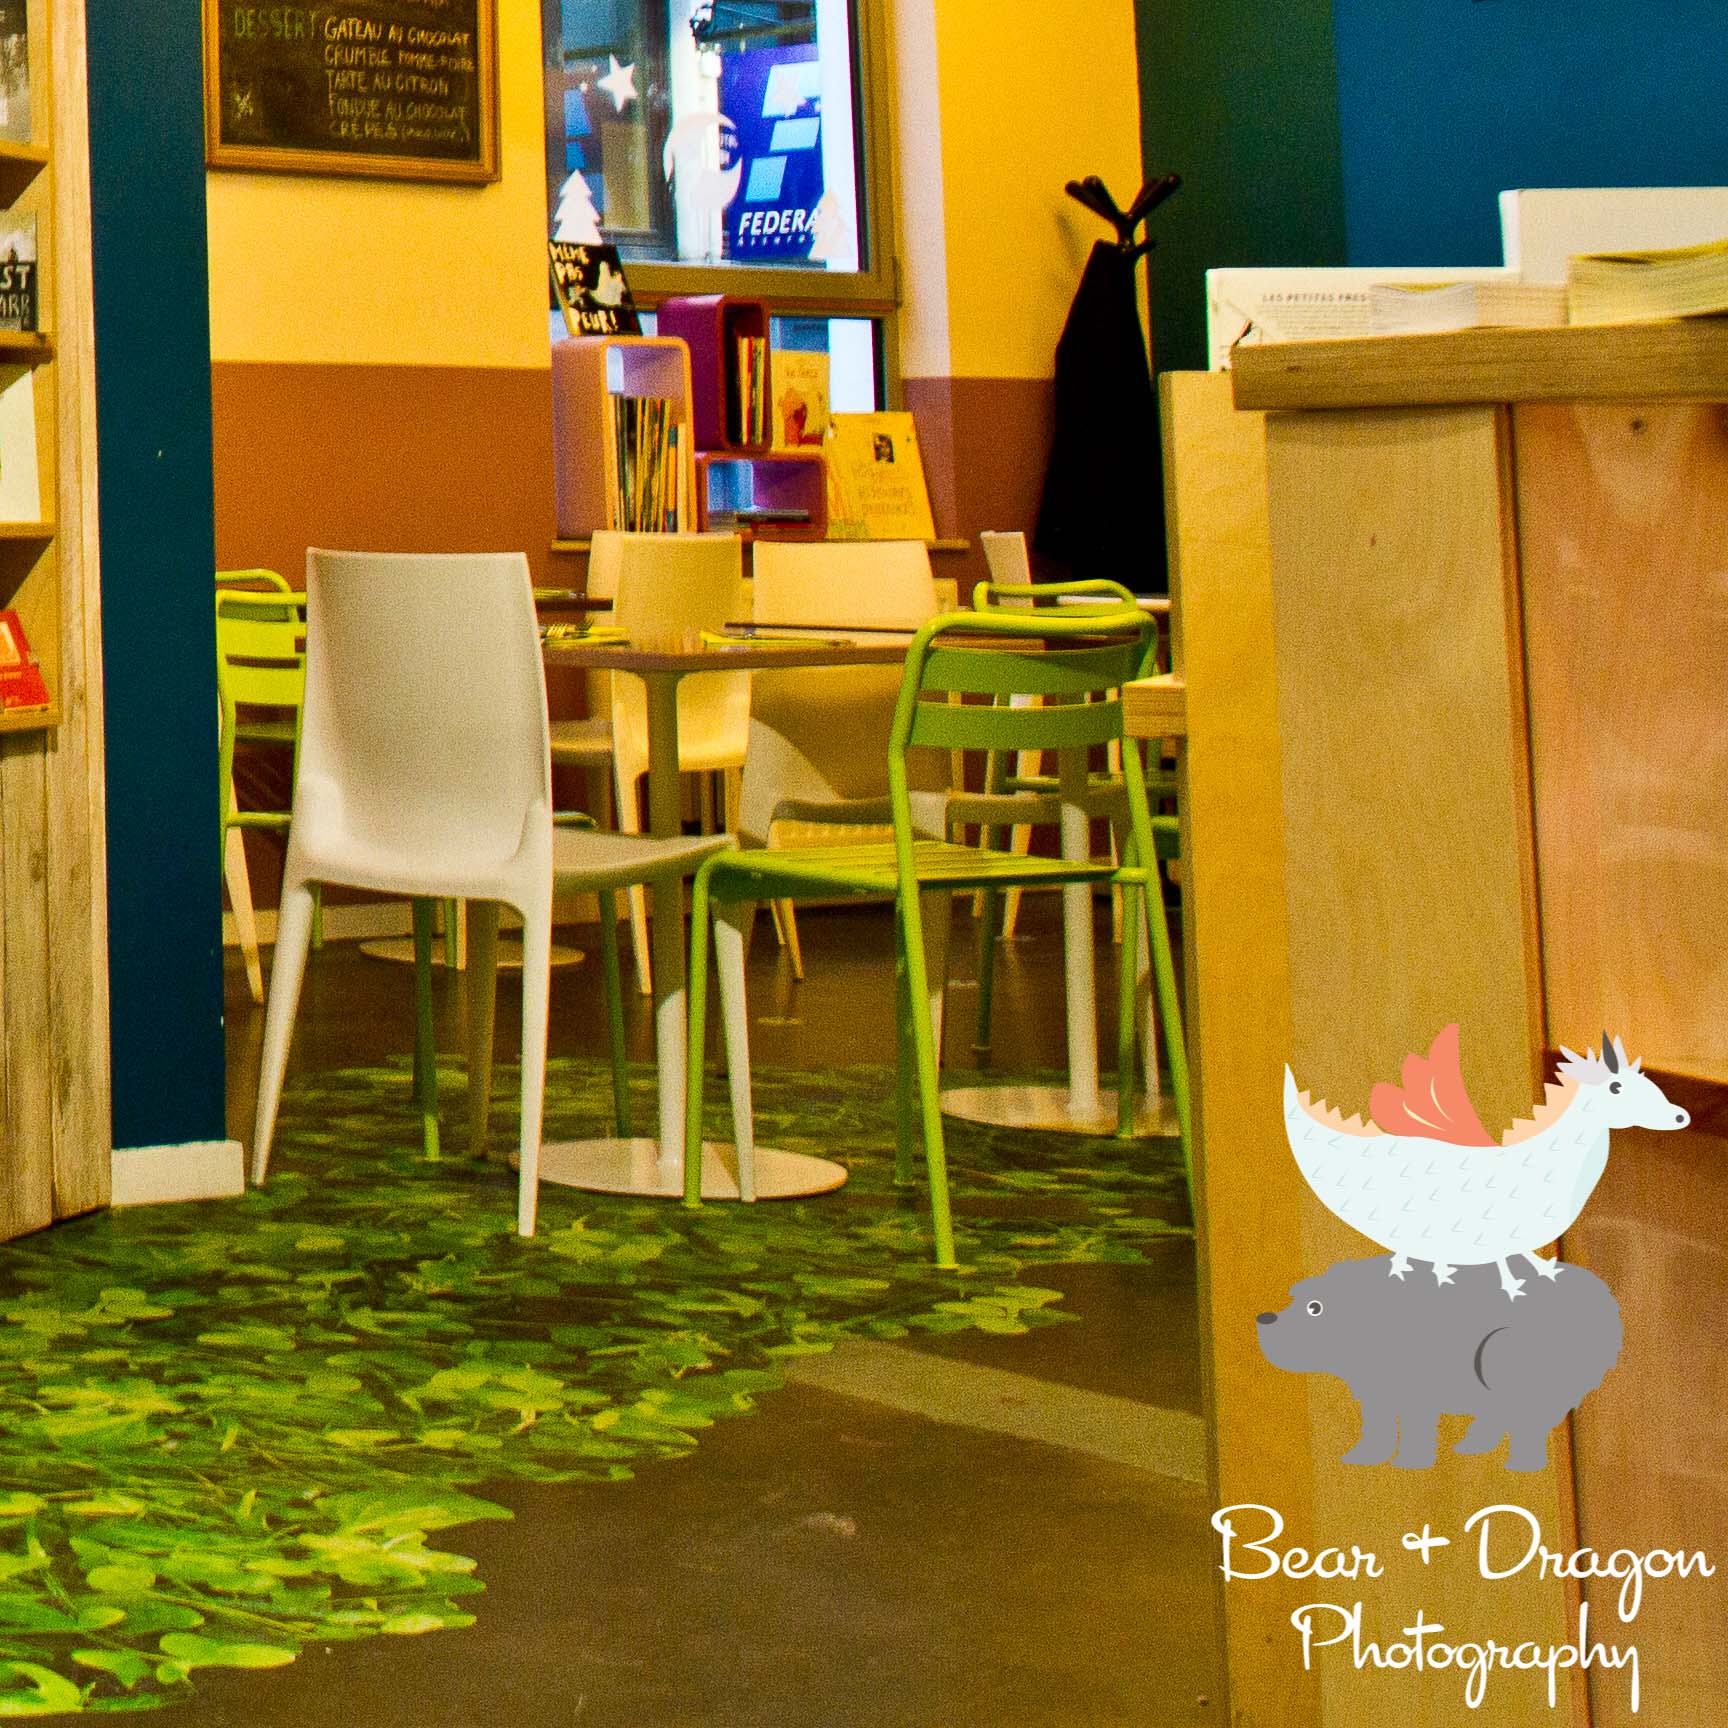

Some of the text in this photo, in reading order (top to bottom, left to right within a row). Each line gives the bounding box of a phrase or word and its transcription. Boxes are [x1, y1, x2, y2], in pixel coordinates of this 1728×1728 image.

[234, 6, 317, 40] DESSERT
[324, 44, 392, 67] CRUMBLE
[326, 69, 368, 93] TARTE
[372, 73, 391, 92] AU
